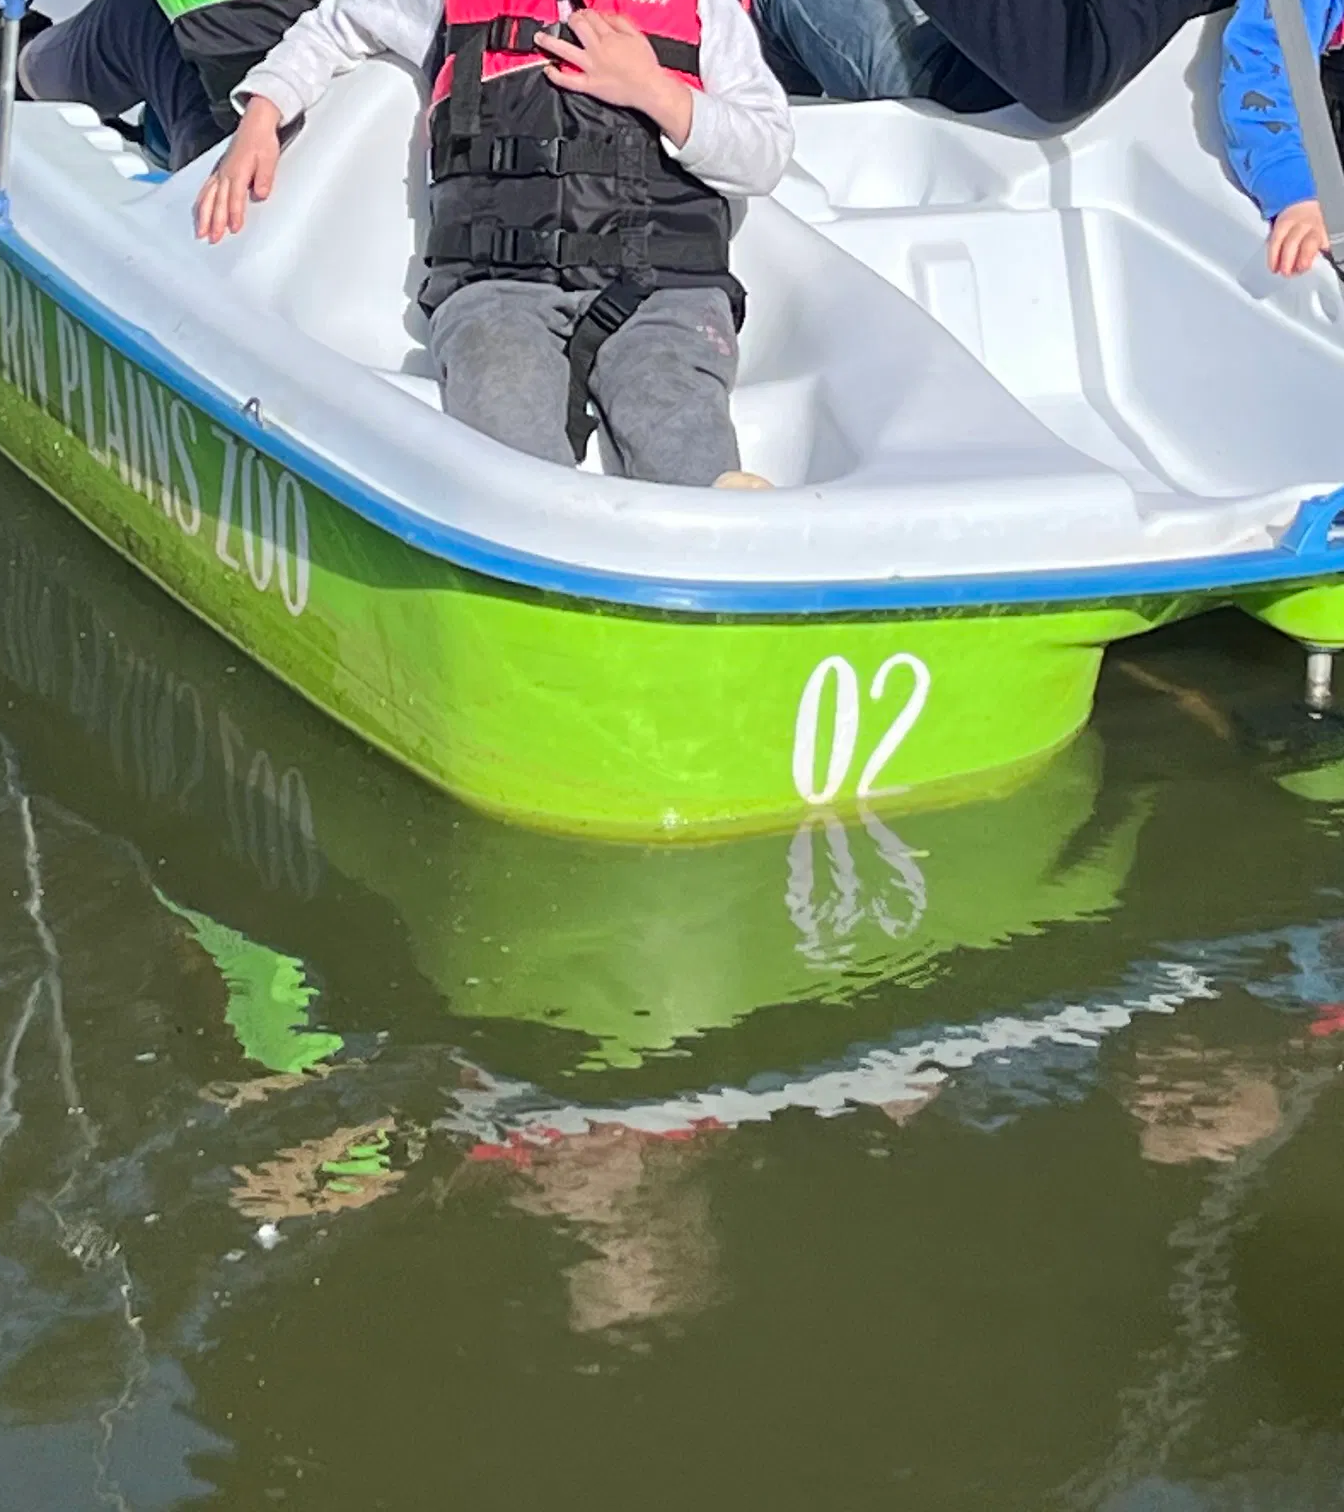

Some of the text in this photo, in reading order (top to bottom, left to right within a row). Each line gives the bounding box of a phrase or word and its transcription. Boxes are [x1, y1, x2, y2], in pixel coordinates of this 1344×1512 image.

[57, 306, 202, 538] PLAINS
[211, 422, 312, 618] ZOO
[792, 652, 931, 805] 02
